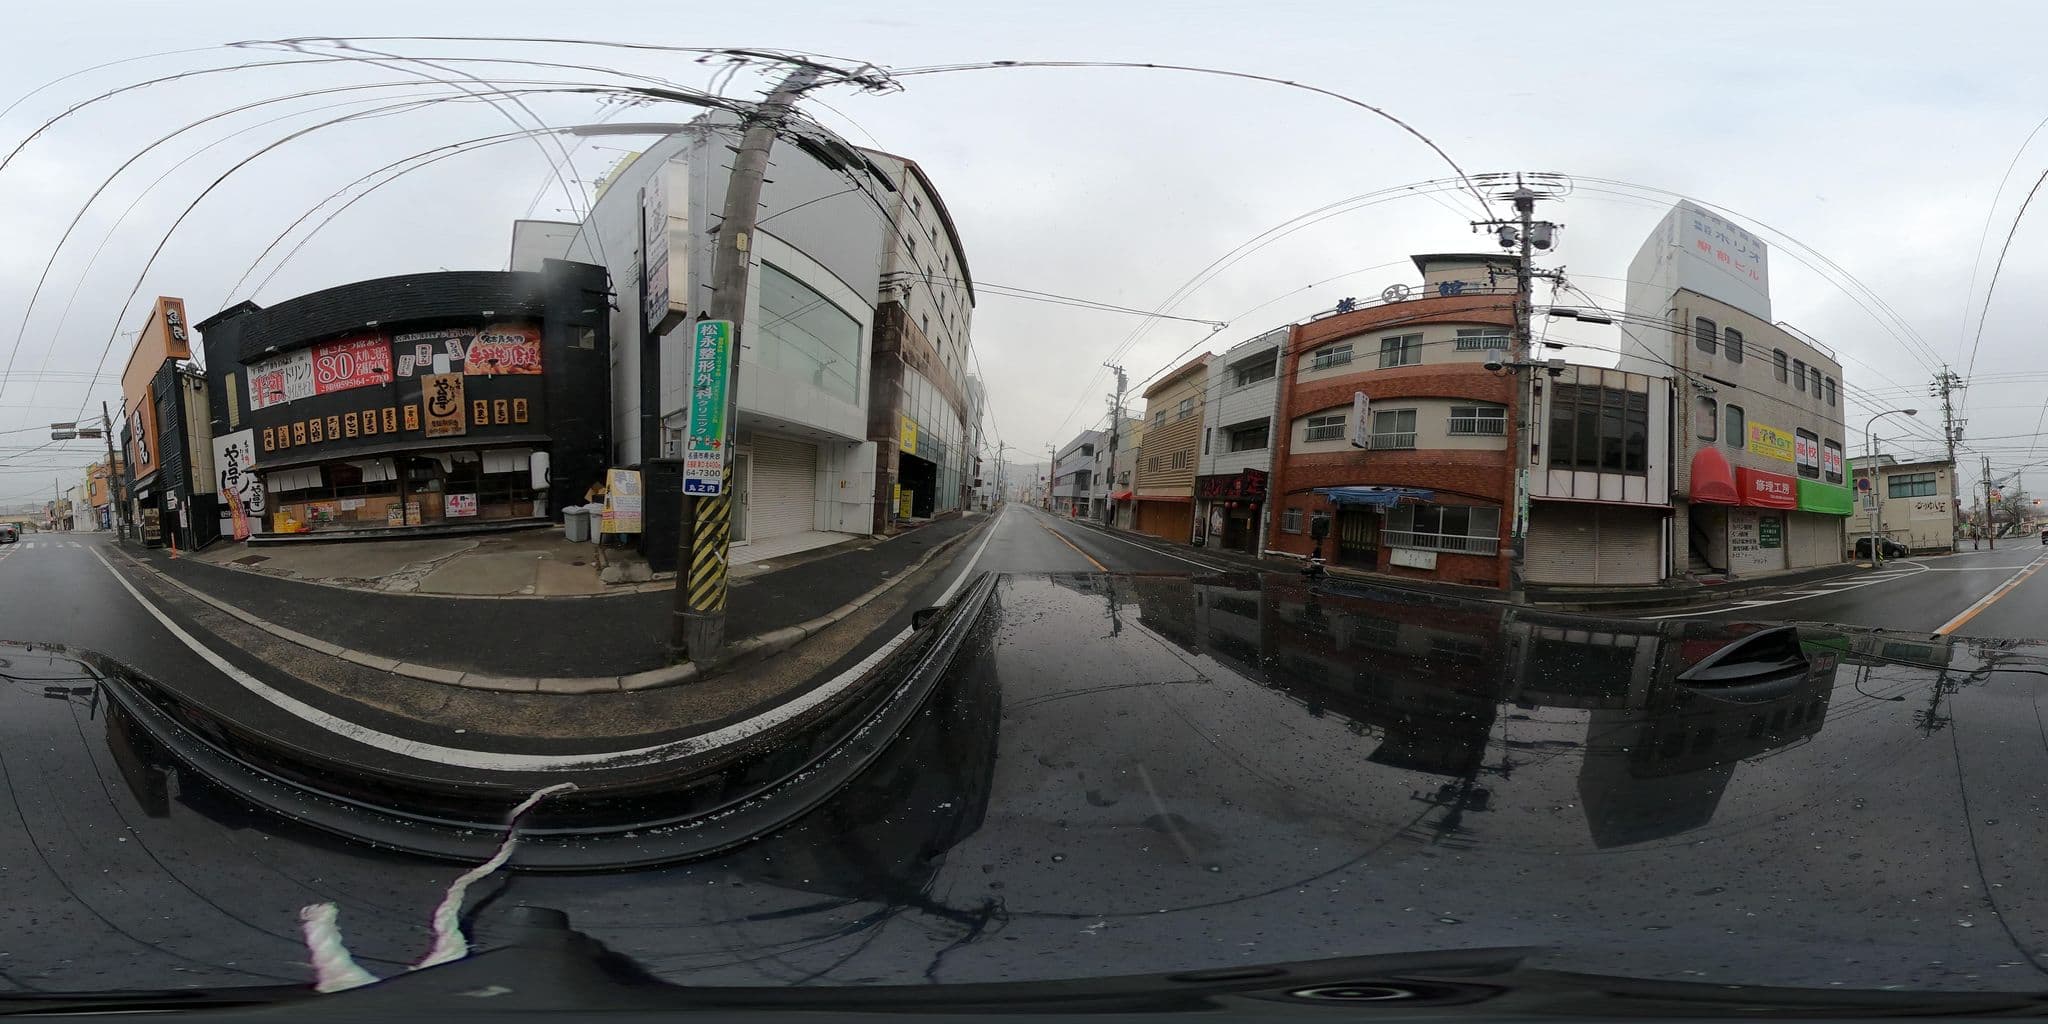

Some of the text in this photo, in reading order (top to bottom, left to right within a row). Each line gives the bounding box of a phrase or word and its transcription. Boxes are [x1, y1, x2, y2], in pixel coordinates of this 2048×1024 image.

[1696, 239, 1760, 281] 駅前ビル
[317, 352, 354, 383] 80
[696, 324, 718, 434] 松永整形外科クリニック
[295, 426, 304, 441] いか
[686, 469, 721, 478] 64-7300
[1755, 480, 1790, 495] 修理工房
